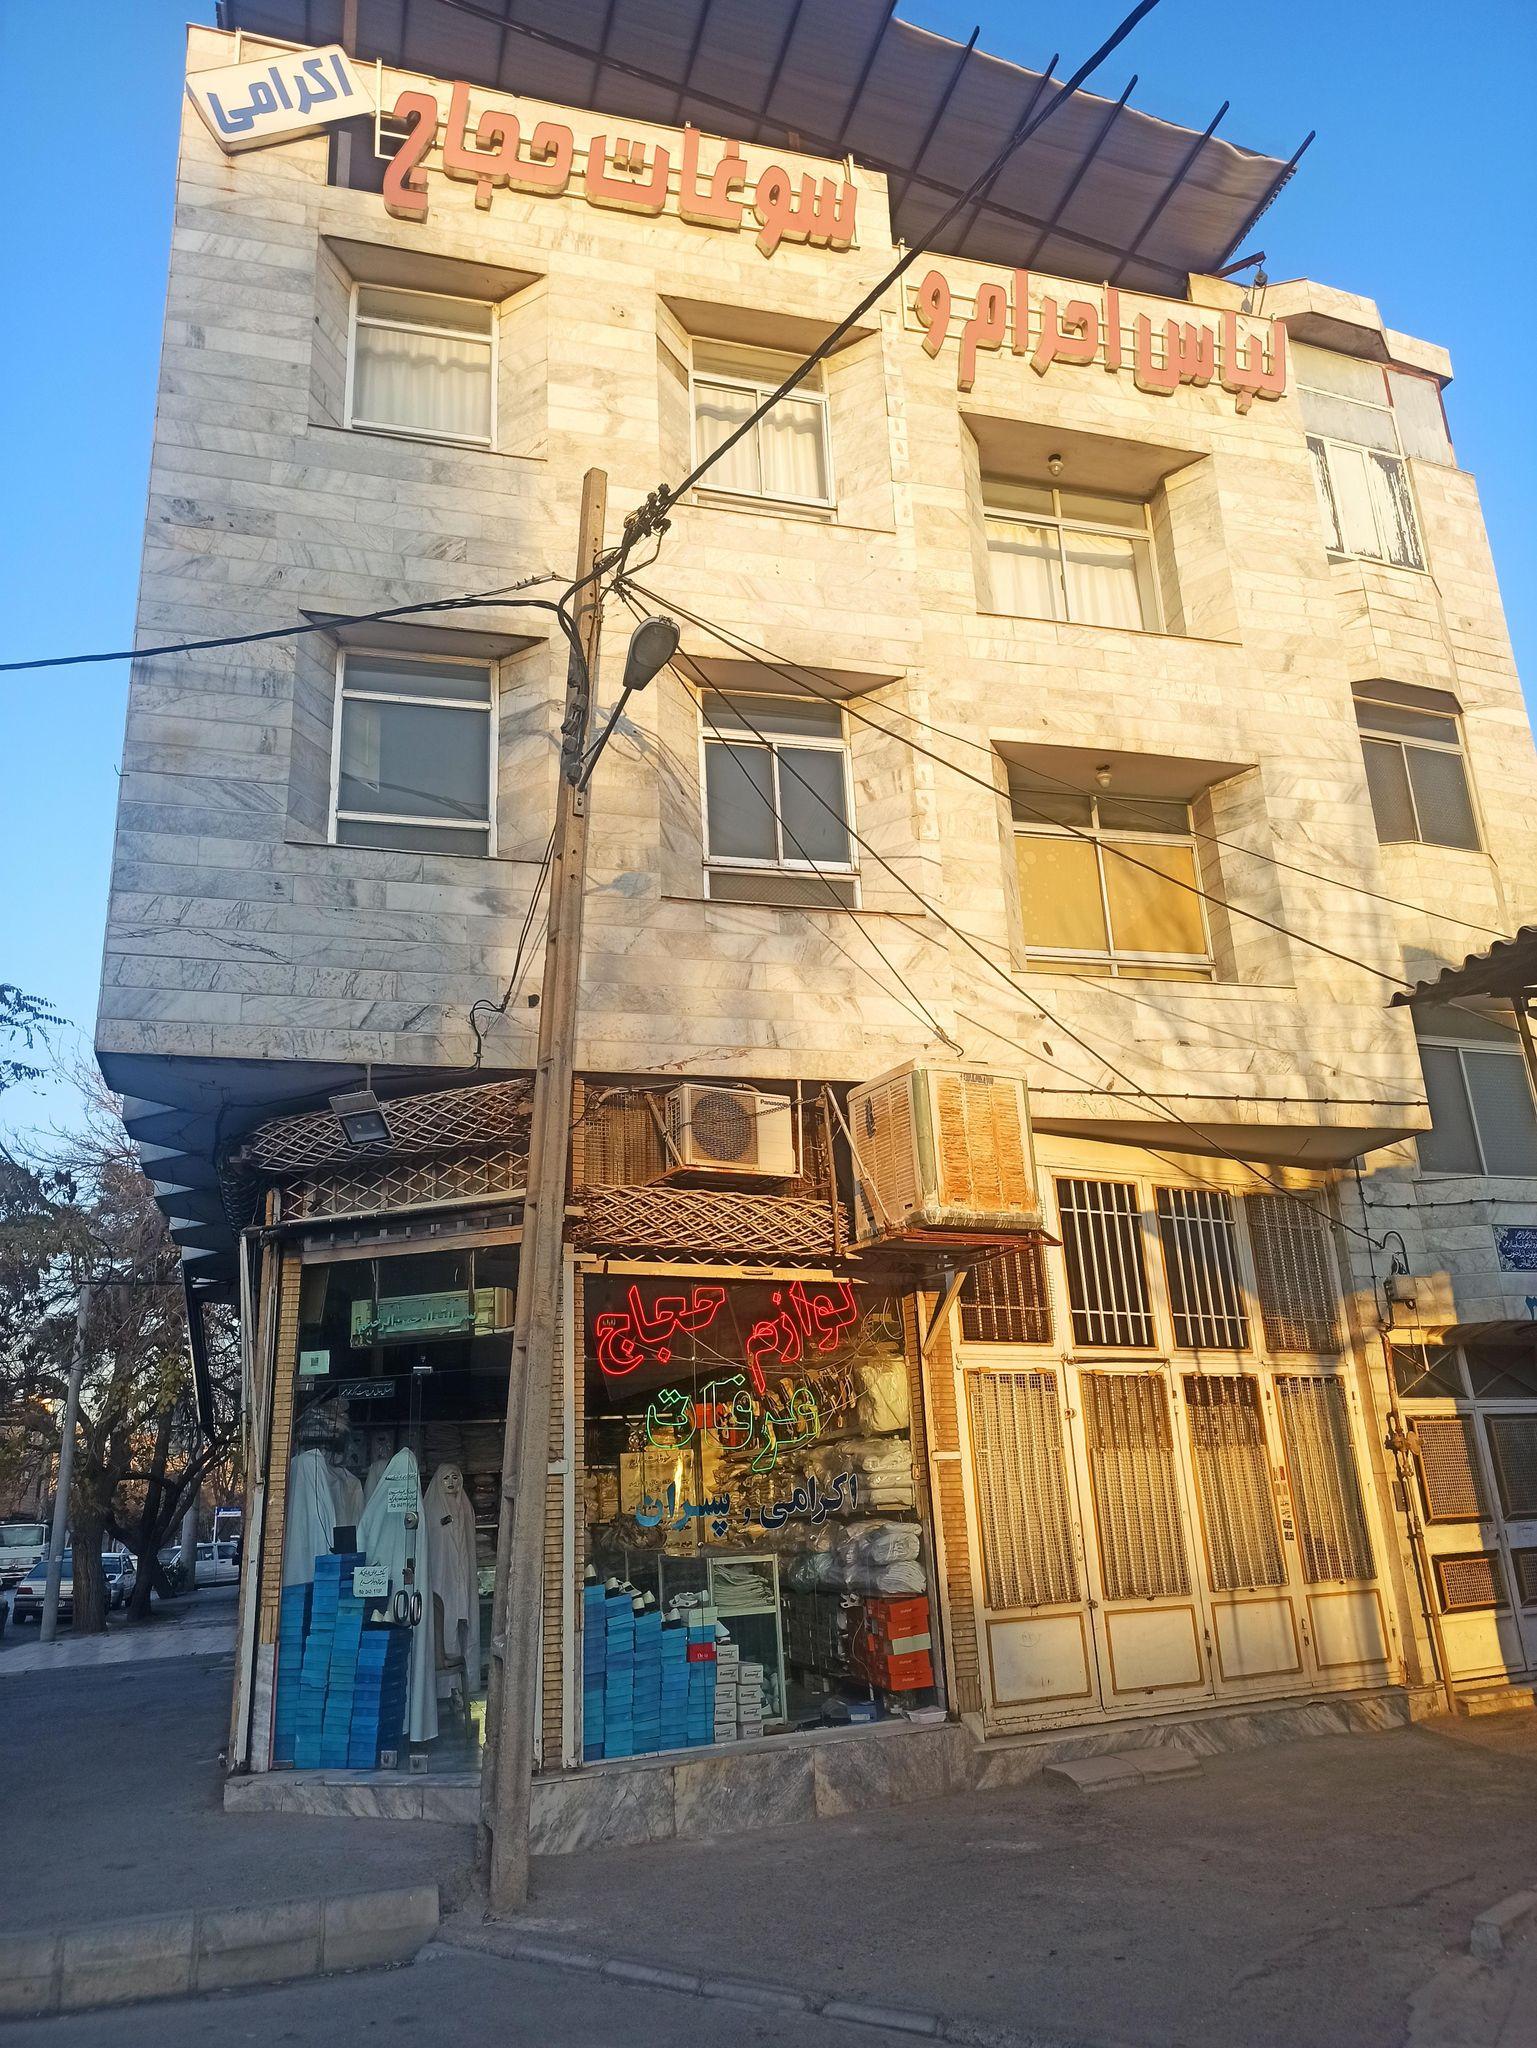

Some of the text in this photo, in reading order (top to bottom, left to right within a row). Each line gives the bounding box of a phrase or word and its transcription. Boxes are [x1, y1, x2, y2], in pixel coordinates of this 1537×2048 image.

[207, 54, 354, 132] اکرامی
[383, 80, 858, 258] سوغات حجاج
[915, 269, 1286, 414] لباس احرام و
[597, 1280, 857, 1394] لوازم حجاج
[646, 1373, 820, 1473] عرفات
[635, 1482, 731, 1538] پسران
[759, 1471, 859, 1530] اکرامی
